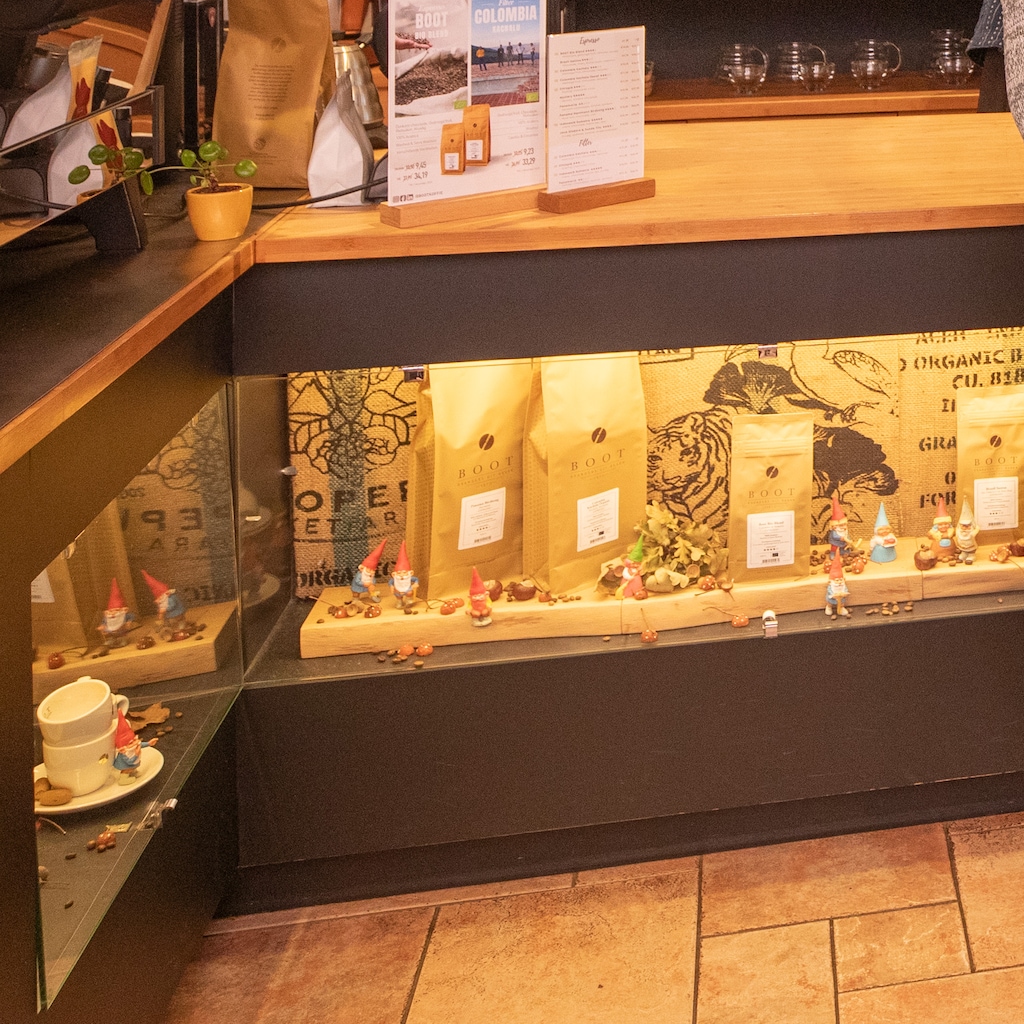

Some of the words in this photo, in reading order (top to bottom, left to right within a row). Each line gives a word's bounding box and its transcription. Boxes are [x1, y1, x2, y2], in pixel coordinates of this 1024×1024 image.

[474, 5, 537, 24] COLOMBIA
[415, 11, 449, 29] BOOT
[579, 36, 600, 46] Espresso
[578, 138, 592, 146] Filter
[524, 148, 534, 156] 9,23
[522, 157, 535, 166] 33,29
[414, 171, 428, 180] 34,19
[914, 349, 1004, 370] ORGANIC
[952, 374, 983, 389] CU.
[571, 448, 626, 471] BOOT
[974, 456, 1018, 466] BOOT
[458, 456, 514, 479] BOOT
[748, 488, 795, 498] BOOT
